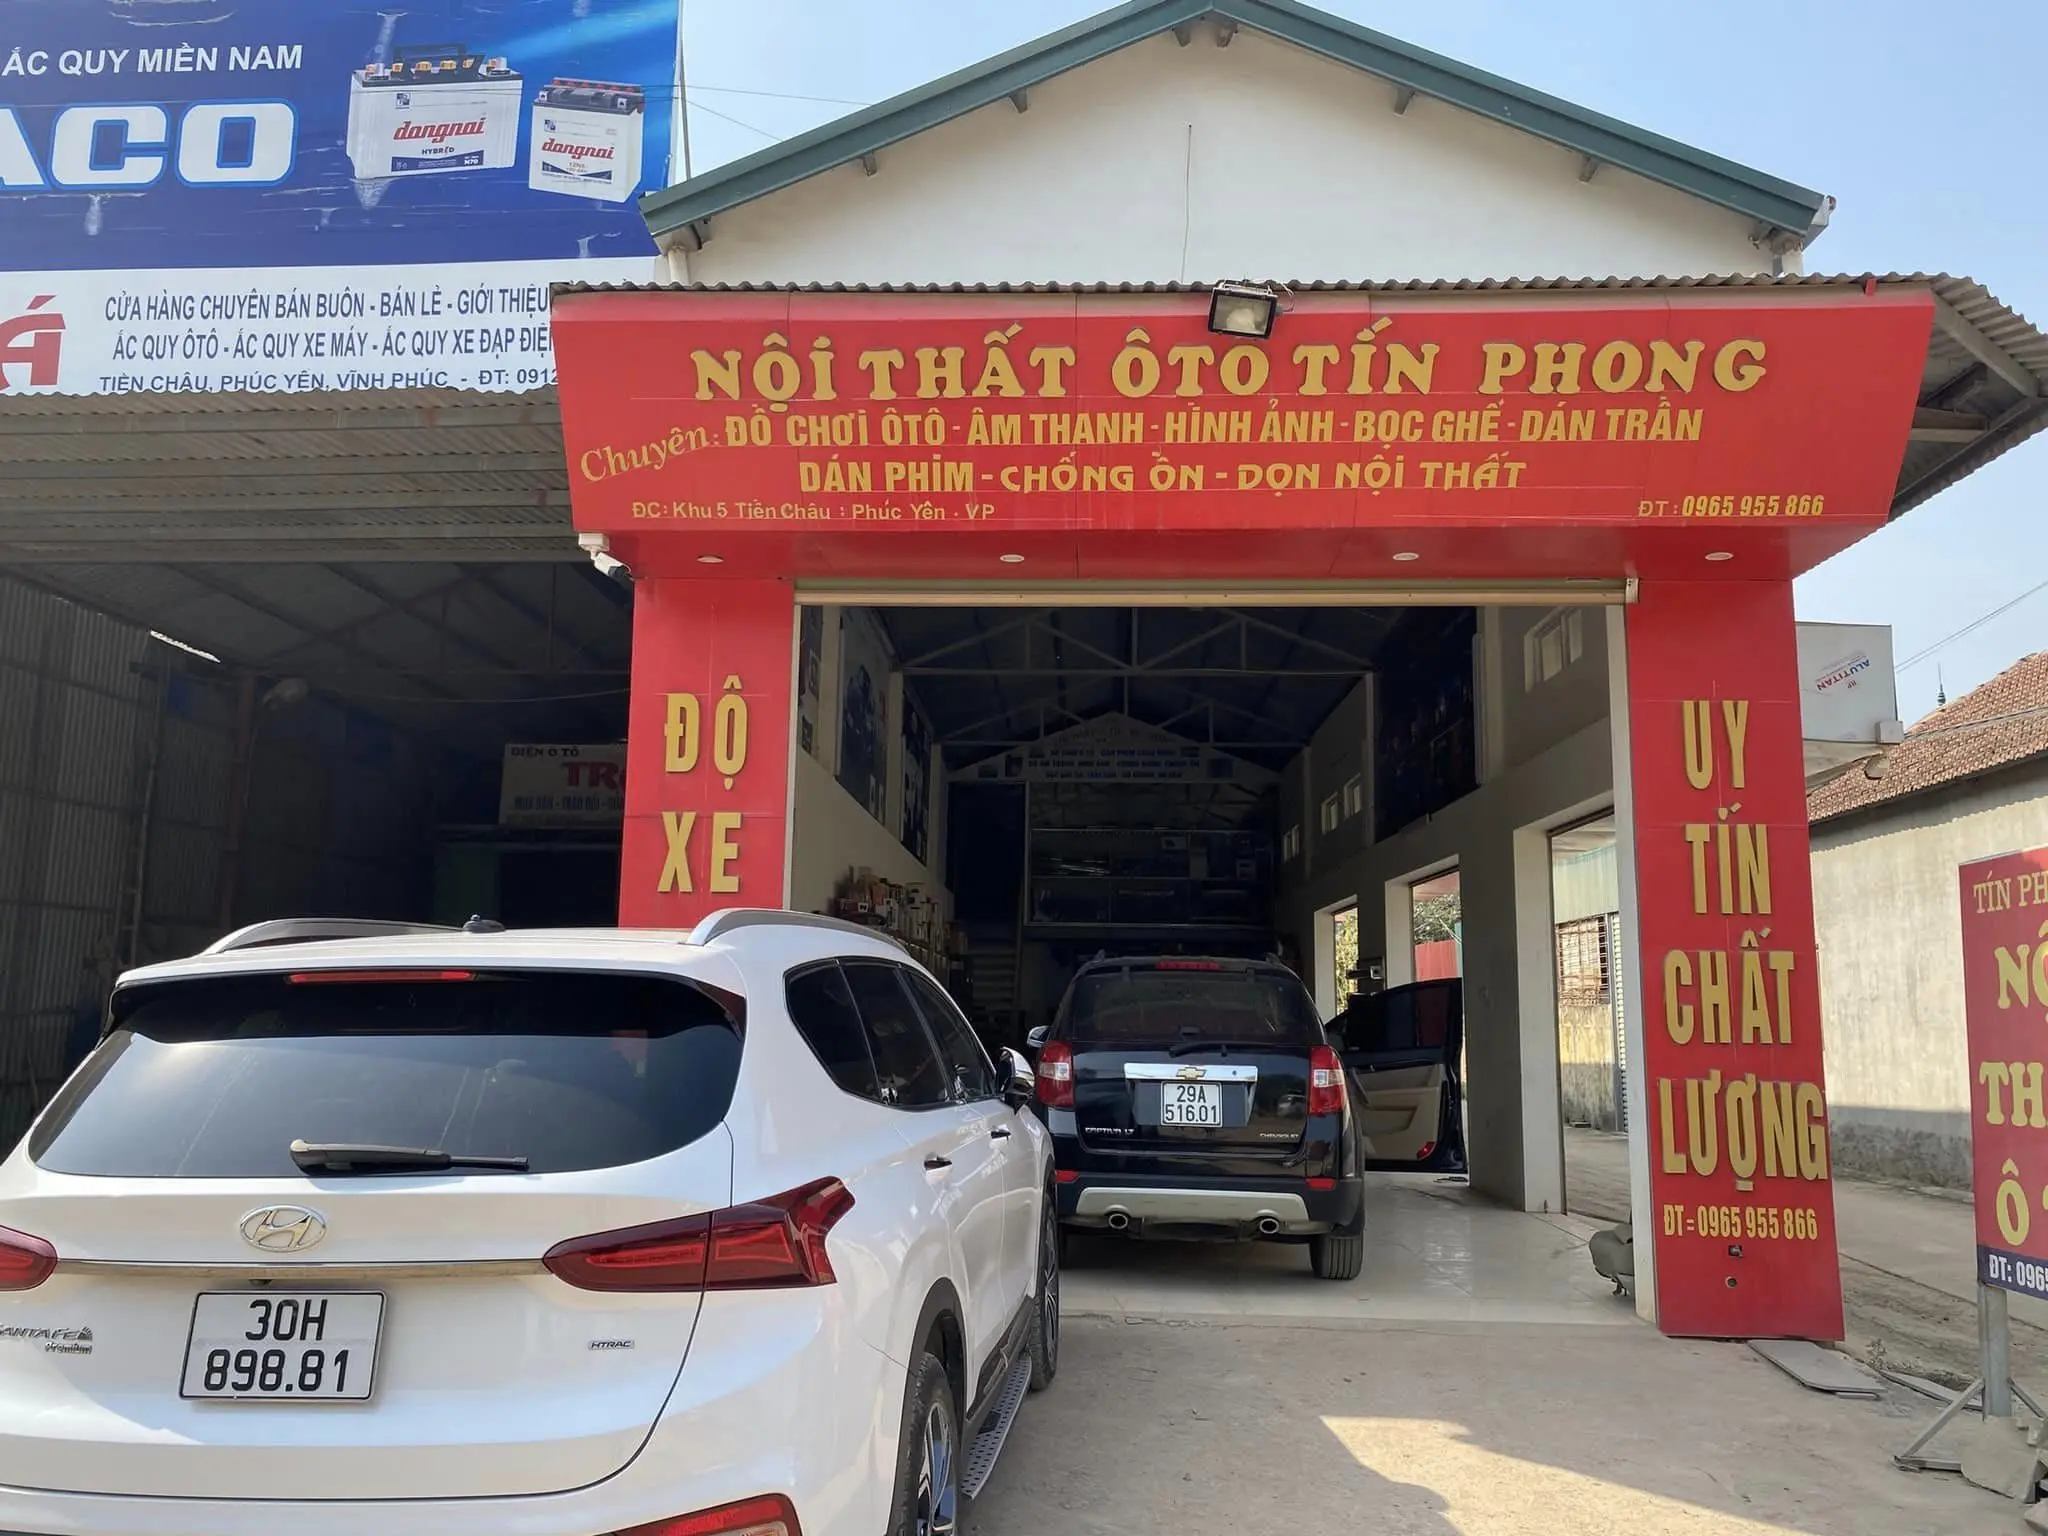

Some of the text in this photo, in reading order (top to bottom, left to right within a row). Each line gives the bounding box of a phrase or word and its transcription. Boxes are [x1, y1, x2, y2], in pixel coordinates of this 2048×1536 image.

[58, 50, 129, 76] QUY
[137, 42, 218, 73] MIỀN
[228, 45, 303, 71] NAM
[105, 283, 548, 321] CỬA HÀNG CHUYÊN BÁN BUÔN BÁN LẺ GIỚI THIỆU
[142, 335, 178, 360] QUY
[183, 328, 219, 359] ÔTÔ
[263, 333, 299, 360] QUY
[303, 333, 326, 358] XE
[331, 326, 368, 357] MÁY
[412, 330, 448, 356] QUY
[453, 329, 474, 355] XE
[480, 327, 515, 359] ĐẠP
[858, 322, 1076, 400] THẤT
[1111, 327, 1269, 398] ÔTO
[1293, 317, 1440, 396] TÍN
[1478, 339, 1766, 395] PHONG
[221, 371, 277, 390] PHÚC
[337, 370, 384, 389] VĨNH
[392, 368, 448, 388] PHÚC
[725, 404, 772, 447] ĐỒ
[881, 407, 945, 447] ÔTÔ
[967, 407, 1021, 446] ÂM
[1029, 412, 1144, 445] THANH
[1259, 398, 1334, 443] ẢNH
[1354, 408, 1424, 450] BỌC
[1432, 398, 1504, 443] GHẾ
[1519, 401, 1596, 442] DÁN
[1606, 396, 1703, 442] TRẦN
[800, 453, 872, 492] DÁN
[885, 454, 974, 492] PHIM
[1000, 451, 1134, 494] CHỐNG
[1237, 462, 1321, 497] DỌN
[1334, 454, 1405, 496] NỘI
[1420, 450, 1527, 491] THẤT
[673, 502, 712, 519] Khu
[716, 502, 728, 518] 5
[735, 499, 776, 519] Tiền
[781, 502, 831, 520] Châu
[852, 499, 902, 520] Phúc
[910, 501, 946, 520] Yên
[965, 504, 995, 520] VP
[1682, 496, 1735, 517] 0965
[1740, 496, 1780, 517] 955
[1785, 495, 1825, 517] 866
[1816, 659, 1870, 691] ALUTITAN
[664, 674, 748, 790] ĐỘ
[1683, 700, 1749, 789] UY
[657, 811, 742, 892] XE
[1684, 802, 1772, 914] TÍN
[1973, 870, 2012, 914] TÍN
[1663, 927, 1795, 1045] CHẤT
[1165, 1104, 1217, 1123] 516.01
[1177, 1085, 1206, 1103] 29A
[1657, 1070, 1828, 1192] LƯỢNG
[1697, 1205, 1742, 1238] 0965
[1745, 1206, 1780, 1239] 955
[1783, 1208, 1818, 1240] 866
[1996, 1158, 2030, 1246] Ô
[245, 1299, 327, 1341] 30H
[591, 1340, 632, 1348] HTRAC
[204, 1349, 349, 1392] 898.81
